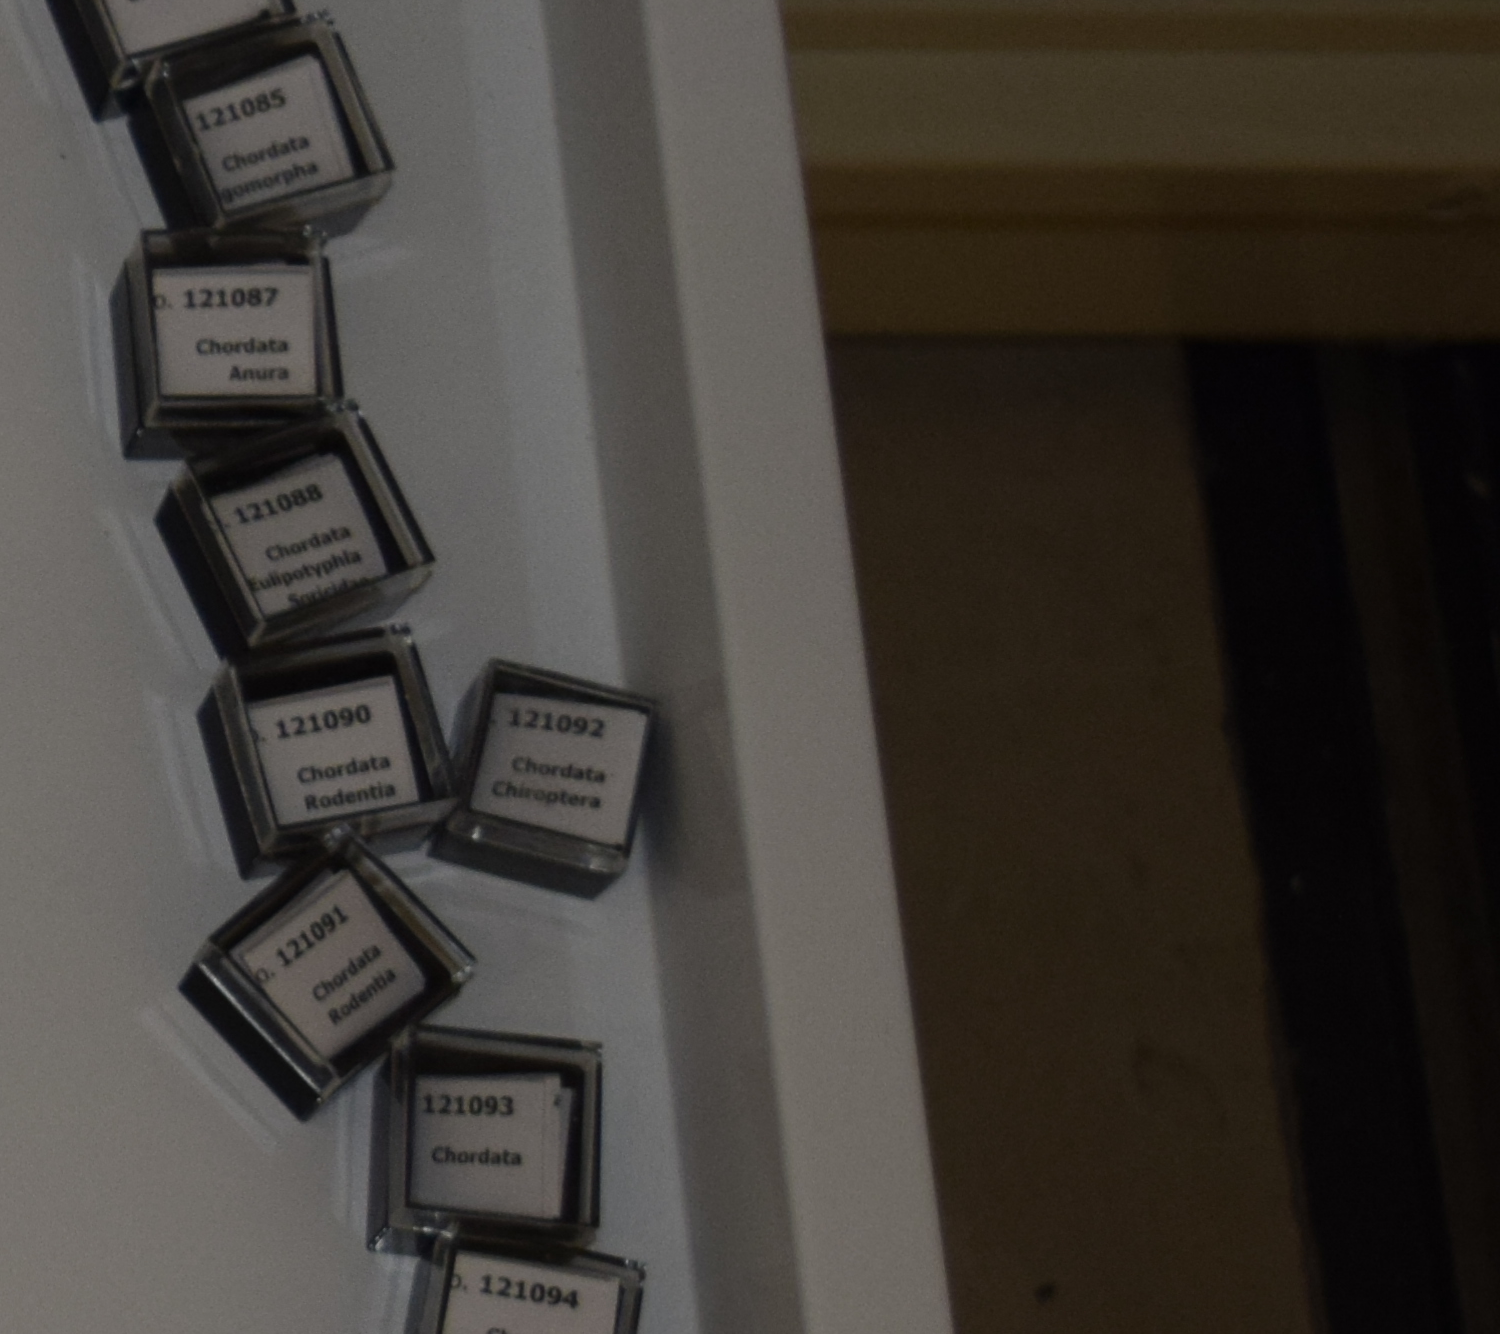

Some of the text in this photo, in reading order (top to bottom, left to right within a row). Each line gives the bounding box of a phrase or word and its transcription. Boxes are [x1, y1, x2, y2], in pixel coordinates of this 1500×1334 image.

[197, 88, 286, 131] 121085
[184, 287, 279, 309] 121087
[196, 338, 289, 355] Chordata
[229, 366, 289, 381] Anura
[234, 484, 323, 524] 121088
[276, 705, 371, 740] 121090
[509, 709, 605, 738] 121092
[276, 905, 348, 967] 121091
[480, 1274, 579, 1310] 121094
